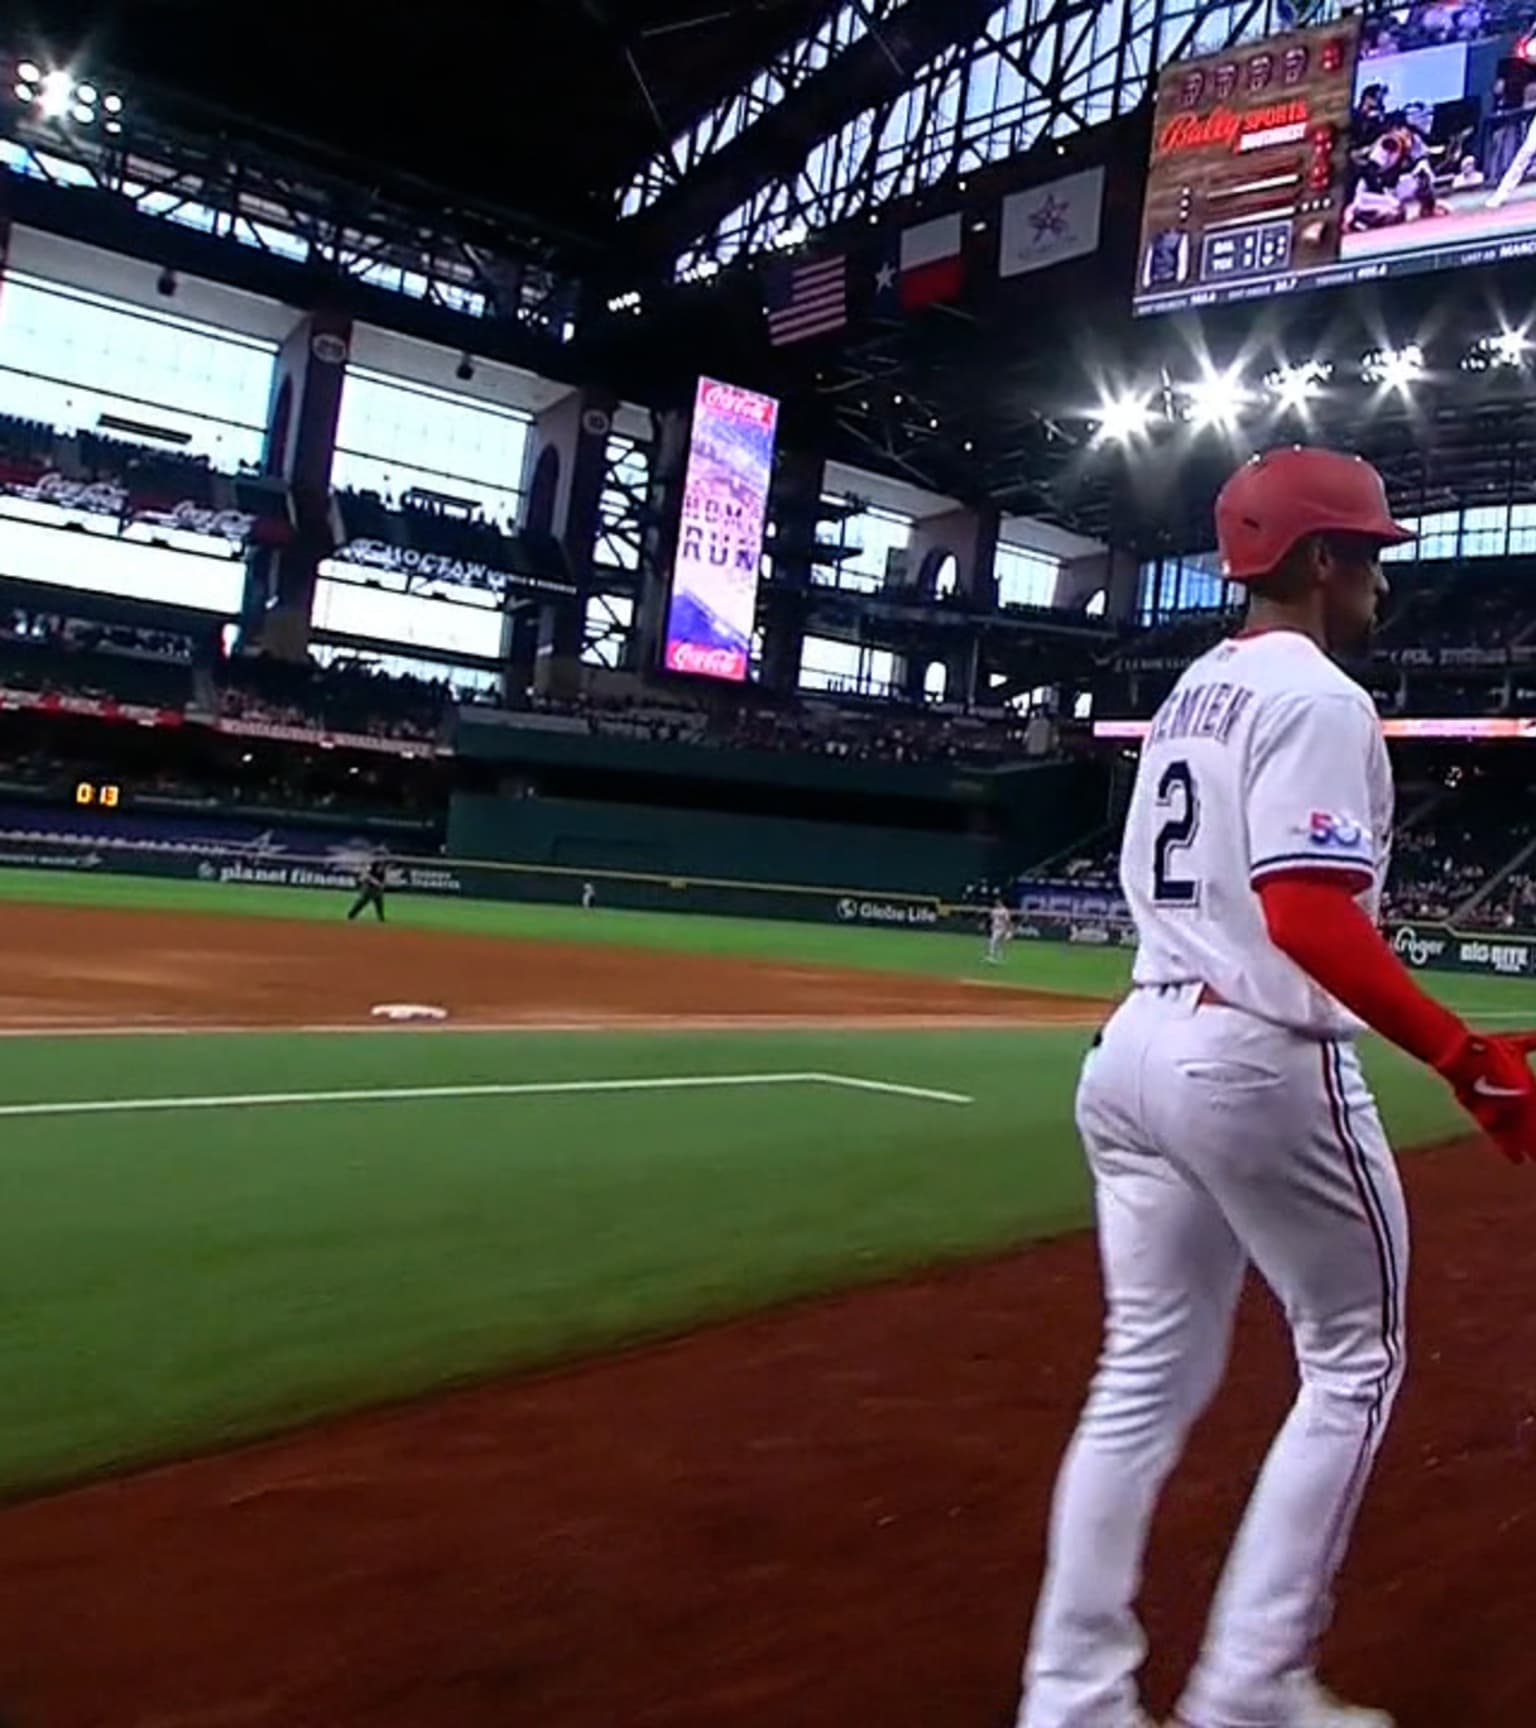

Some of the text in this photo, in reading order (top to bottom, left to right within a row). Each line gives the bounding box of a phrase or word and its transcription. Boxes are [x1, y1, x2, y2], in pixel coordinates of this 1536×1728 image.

[1158, 105, 1241, 157] Bally
[1242, 99, 1308, 132] SPORTS
[683, 525, 754, 571] RUN
[1153, 758, 1201, 908] 2
[219, 861, 357, 888] planet fitness
[861, 902, 937, 923] Globe Life
[1460, 942, 1489, 962] BIG
